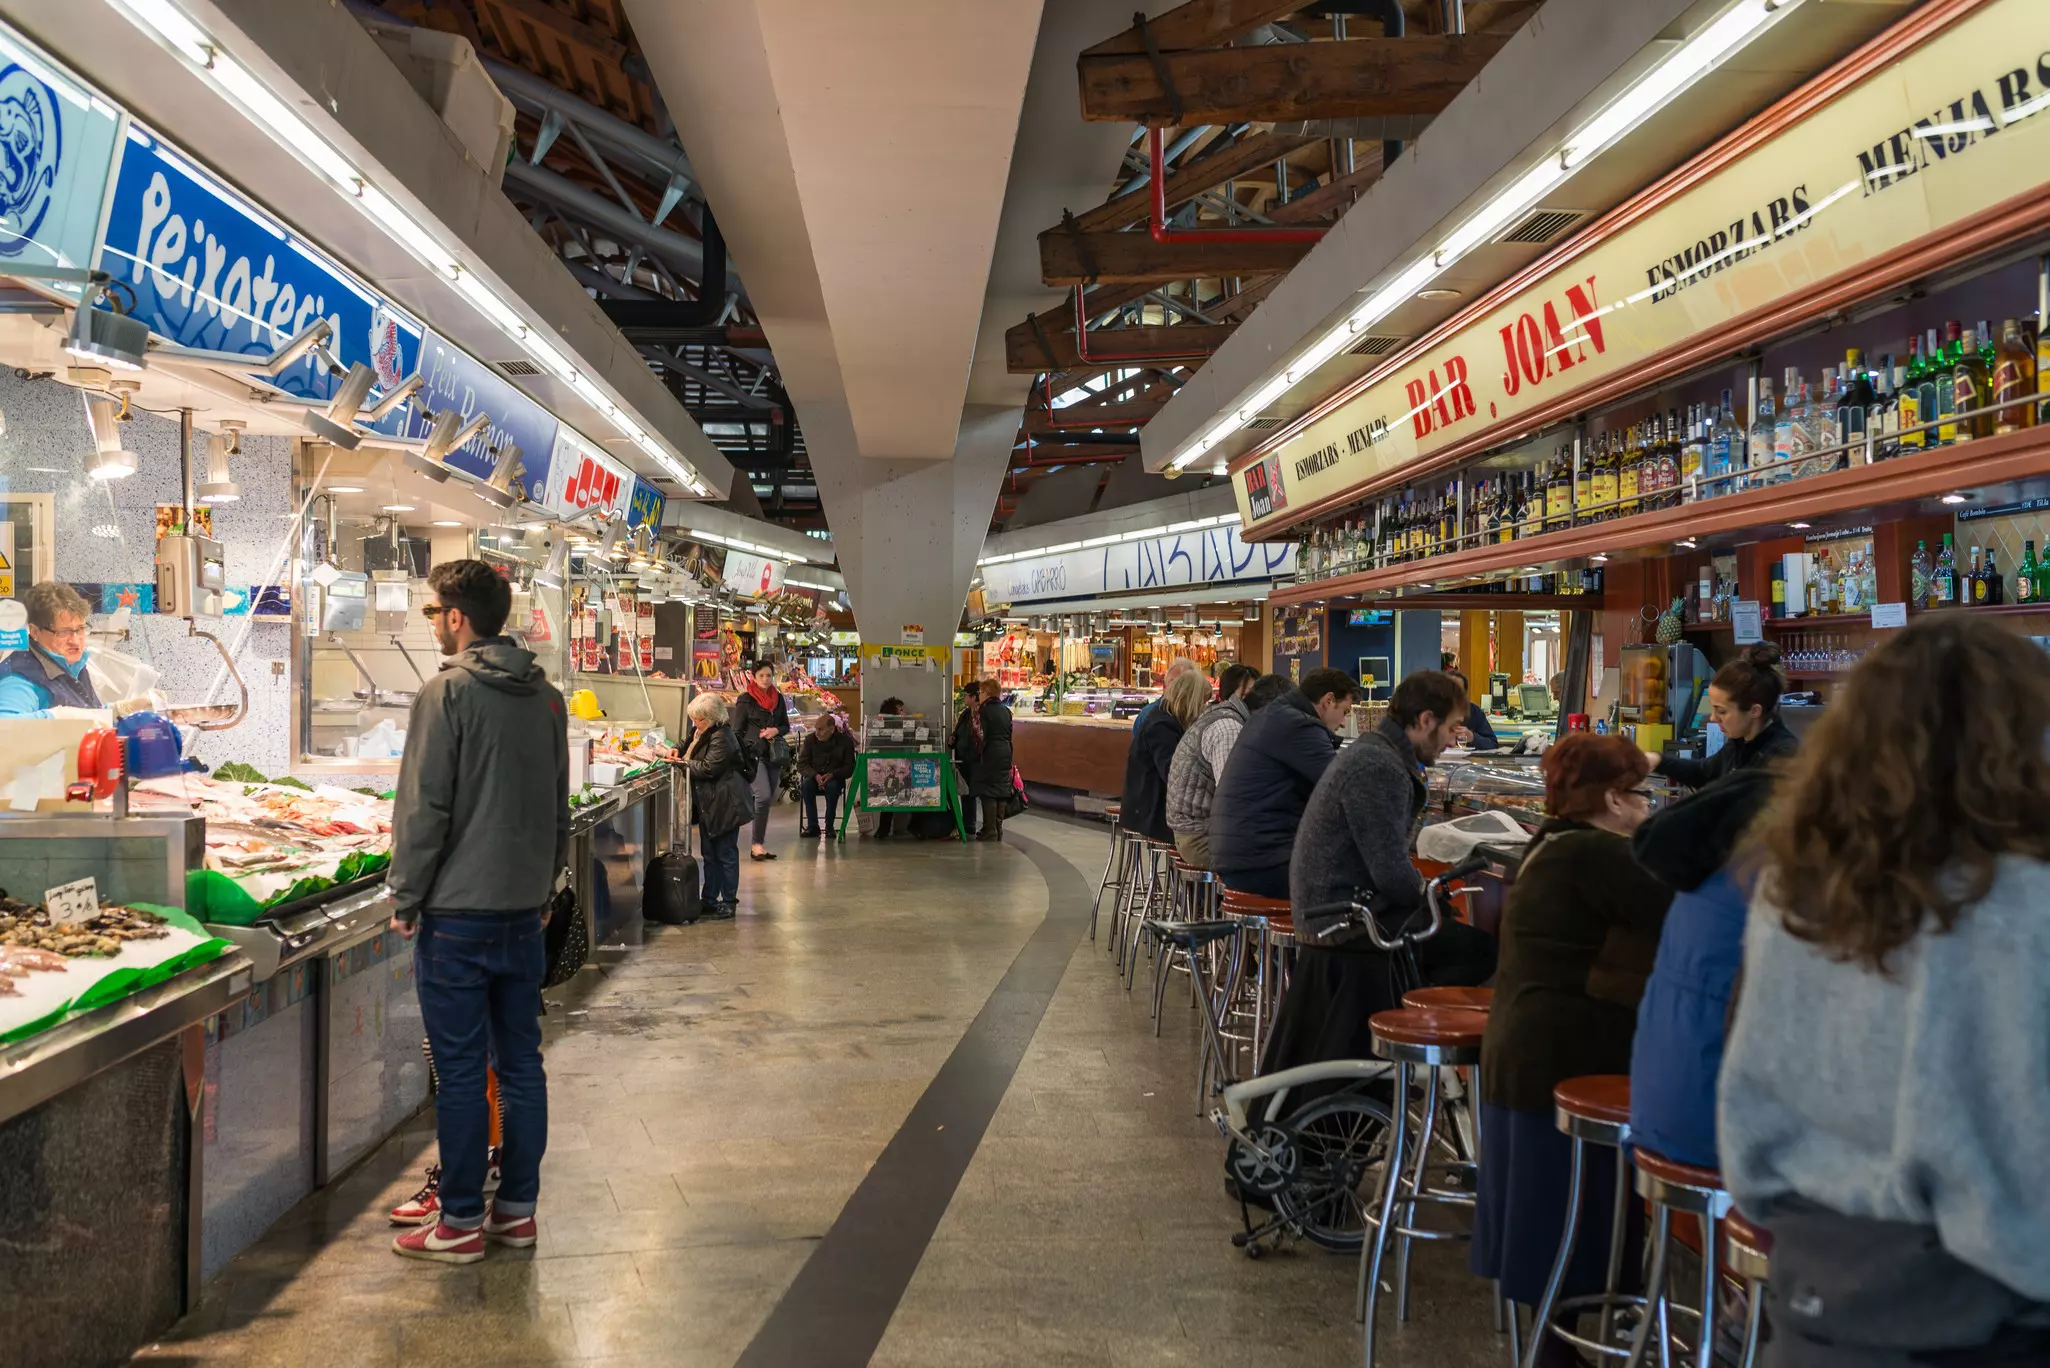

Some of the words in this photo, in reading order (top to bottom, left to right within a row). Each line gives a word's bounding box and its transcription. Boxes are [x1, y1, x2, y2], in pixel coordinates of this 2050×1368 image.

[1646, 184, 1813, 304] ESMORZARS
[1405, 355, 1477, 439] BAR
[1499, 275, 1605, 396] JOAN
[1295, 441, 1339, 481] ESMORZARS
[1347, 414, 1390, 456] MENJARS
[1245, 463, 1266, 493] BAR
[1249, 494, 1272, 520] Joan
[895, 649, 925, 657] ONCE
